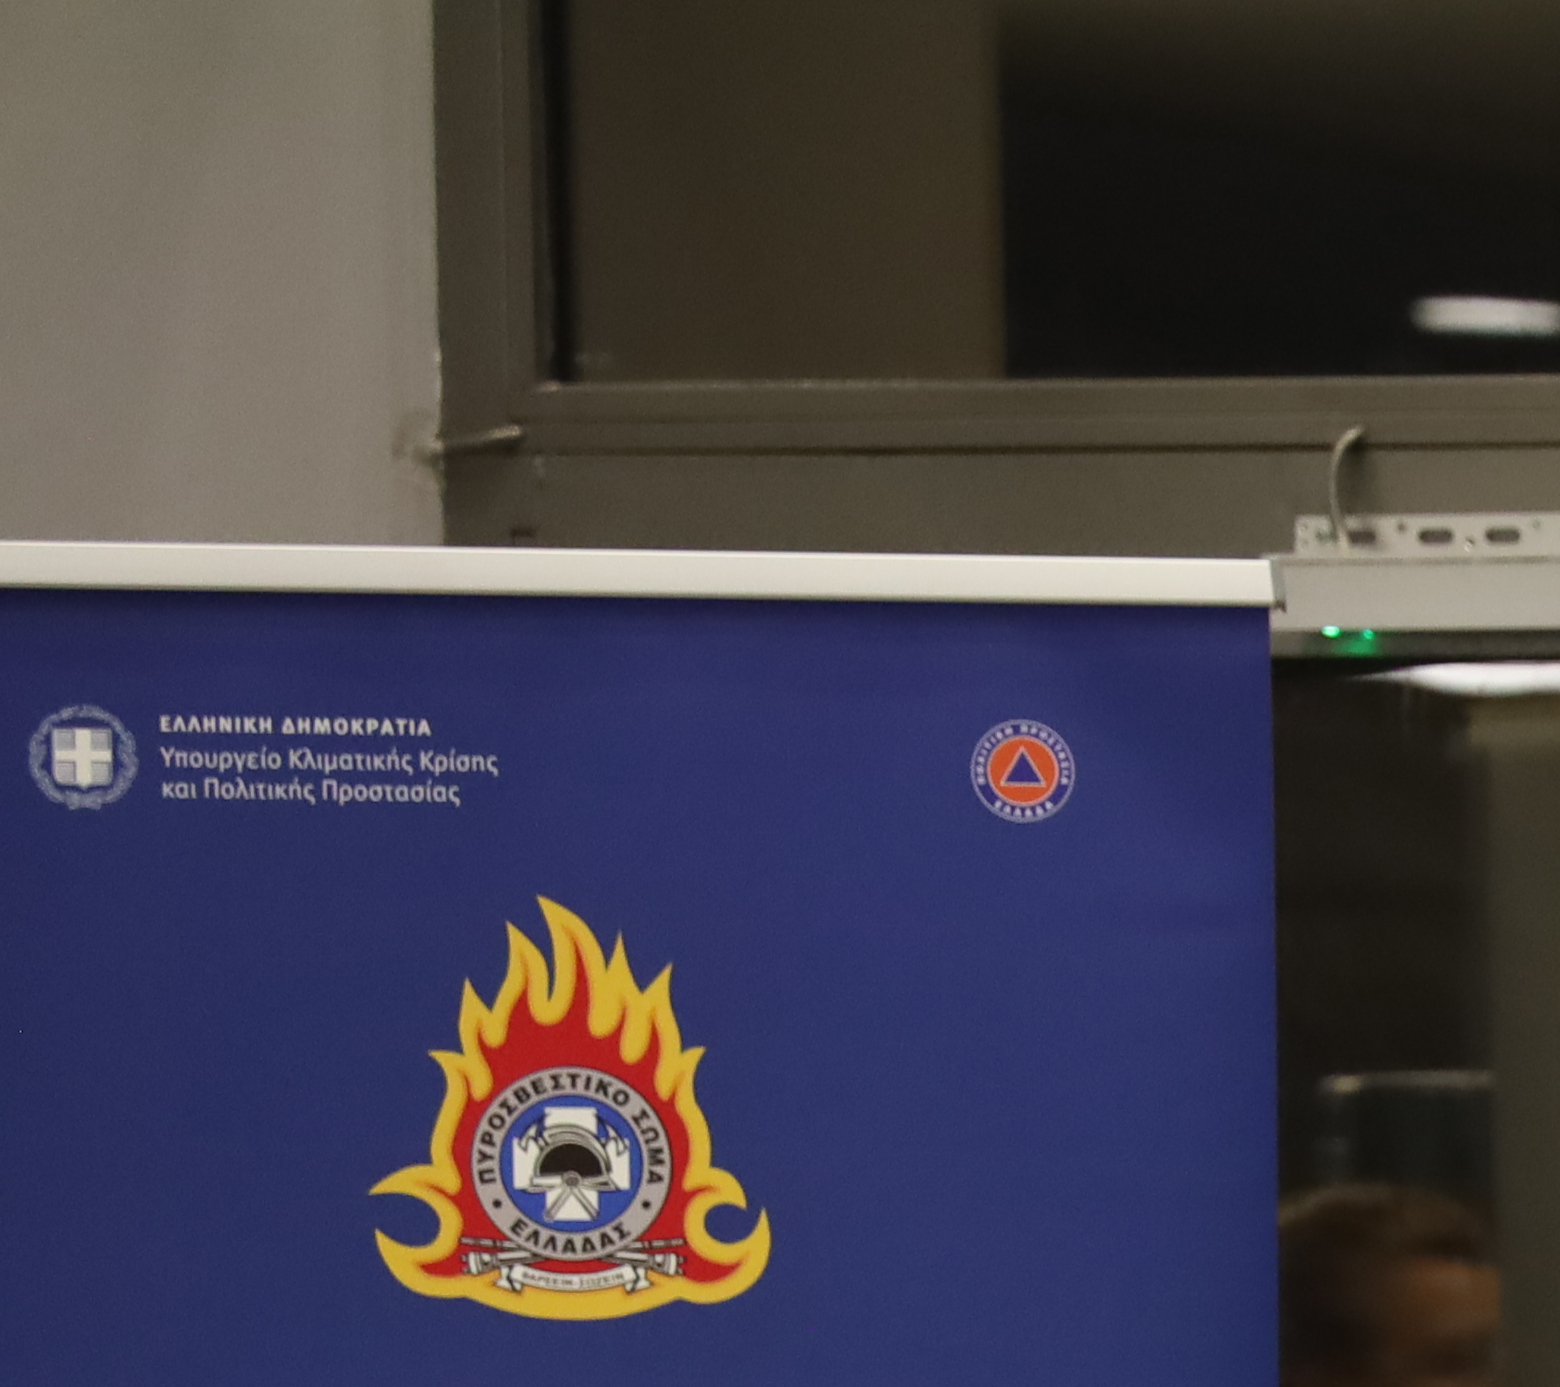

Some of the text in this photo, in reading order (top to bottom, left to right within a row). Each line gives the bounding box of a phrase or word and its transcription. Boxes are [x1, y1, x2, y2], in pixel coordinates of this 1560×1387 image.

[159, 715, 431, 736] ΕΛΛΗΝΙΚΗ ΔΗΜΟΚΡΑΤΙΑ
[160, 745, 499, 777] Υπουργείο Κλιματικής Κρίσης
[162, 777, 461, 807] και Πολιτικής Προστασίας
[478, 1073, 666, 1185] ΠΥΡΟΣΒΕΣΤΙΚΟ ΣΩΜΑ
[509, 1220, 632, 1254] ΕΛΛΑΔΑΣ
